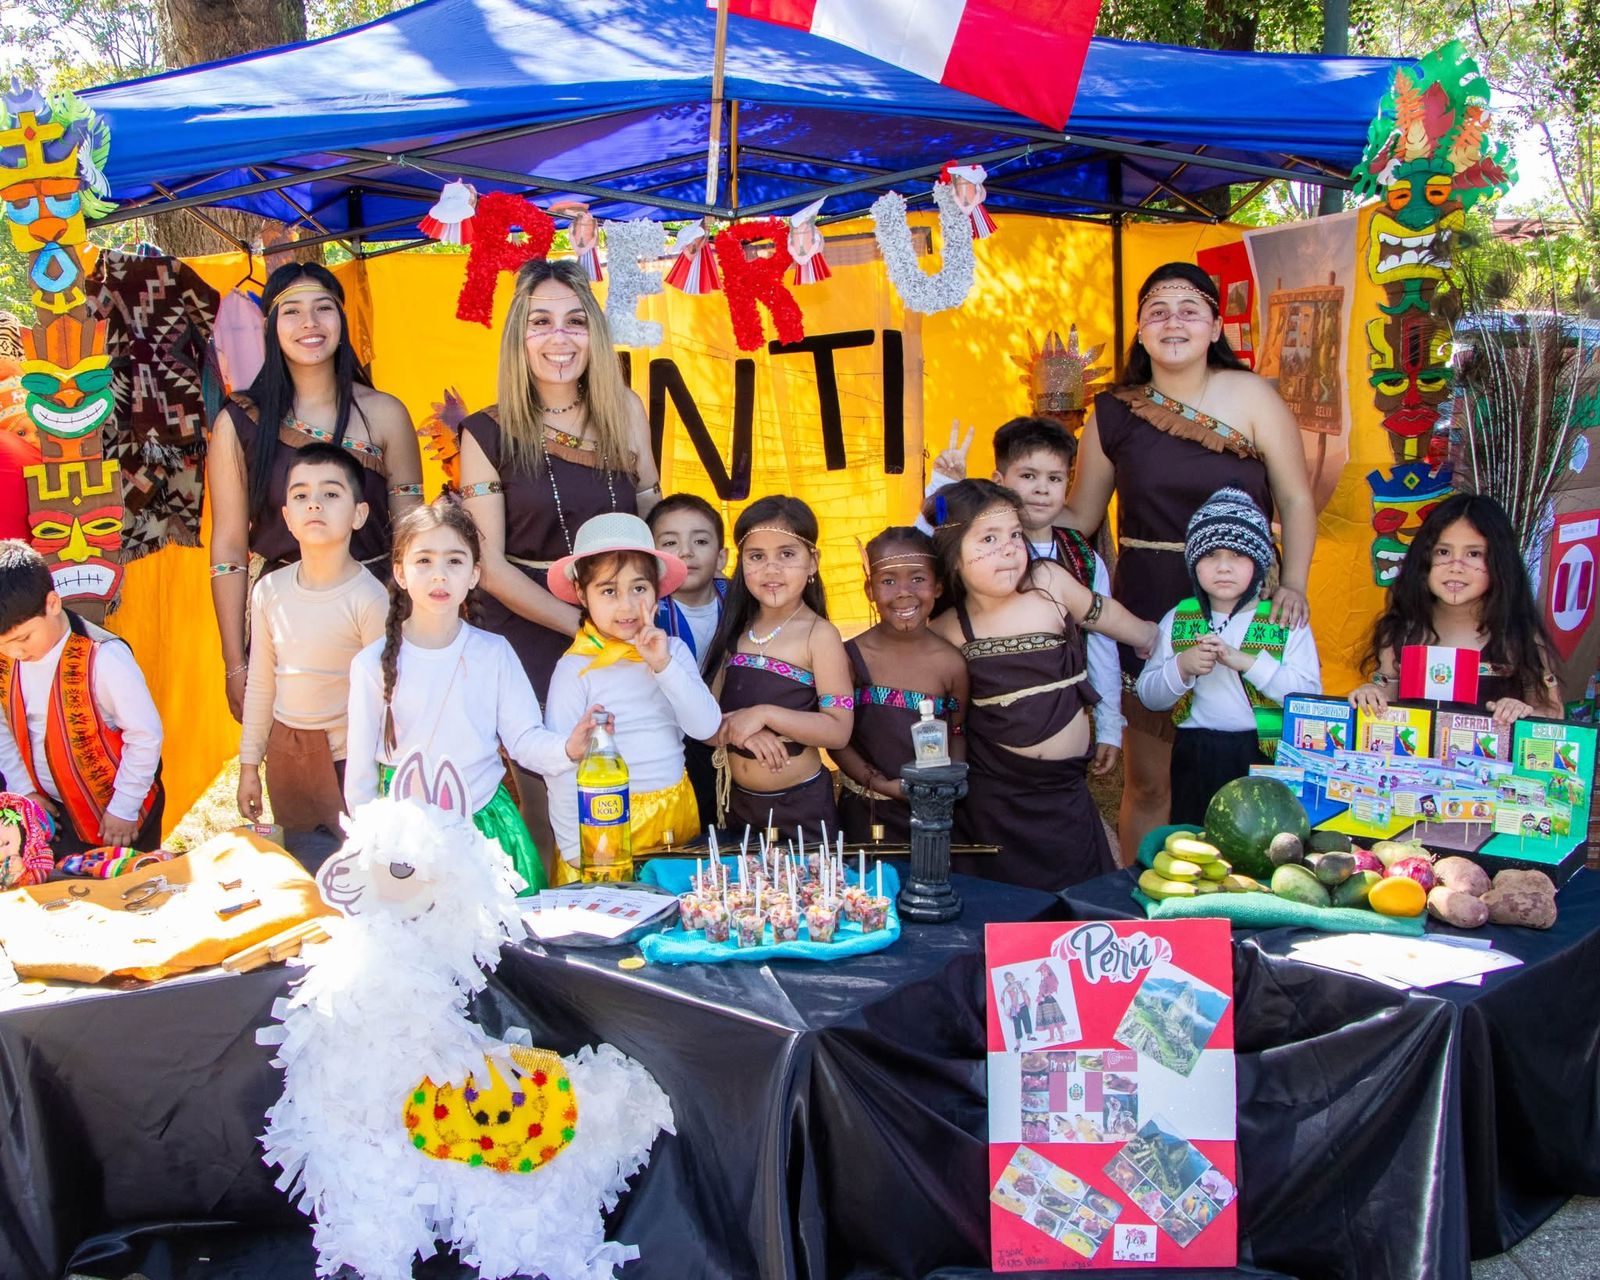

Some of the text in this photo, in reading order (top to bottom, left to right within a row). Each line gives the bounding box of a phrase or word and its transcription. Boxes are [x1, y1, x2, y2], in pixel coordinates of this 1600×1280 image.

[455, 182, 977, 352] PERU
[619, 329, 905, 501] NTI
[1454, 716, 1490, 731] SIERRA
[597, 807, 619, 815] KOLA
[598, 800, 618, 808] INCA
[1070, 923, 1152, 980] Perú
